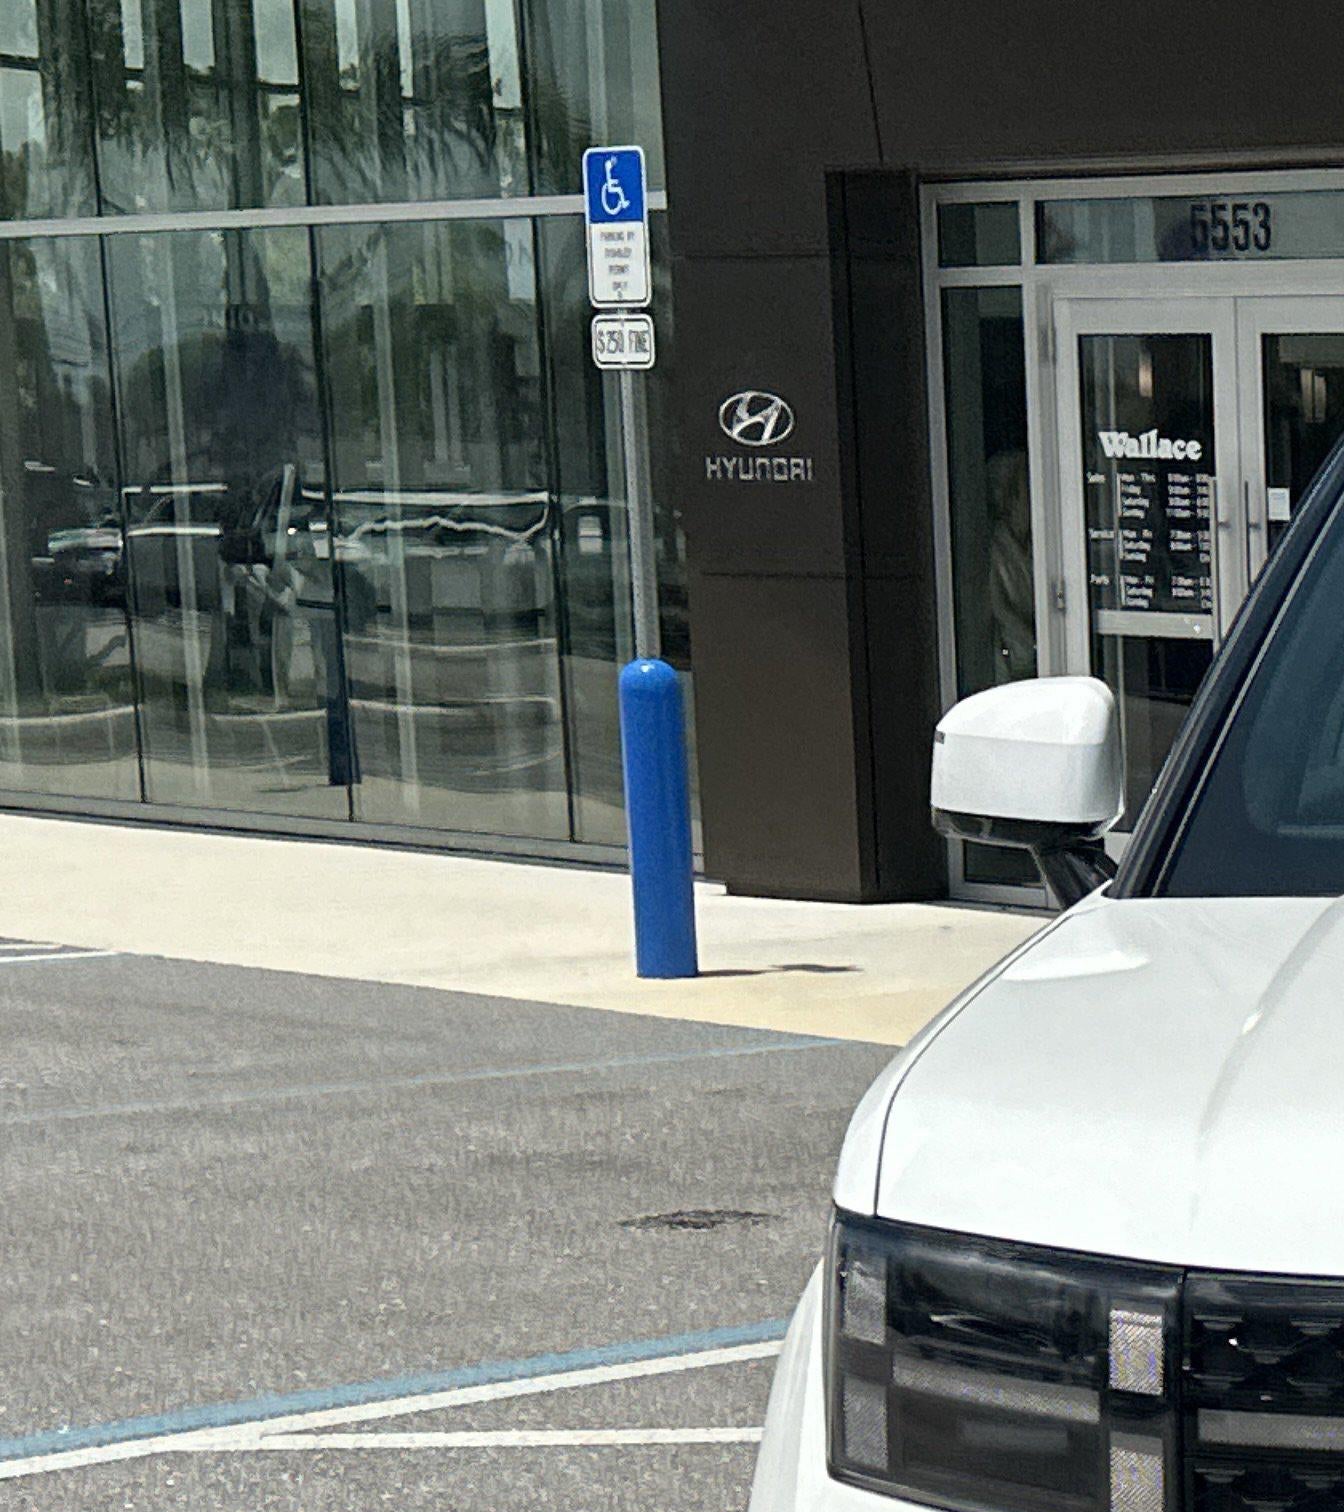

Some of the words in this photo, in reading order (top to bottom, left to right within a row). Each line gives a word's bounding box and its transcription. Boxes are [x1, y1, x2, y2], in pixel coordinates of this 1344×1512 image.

[1190, 202, 1272, 252] 5553
[1098, 428, 1202, 461] Wallace
[705, 457, 814, 481] HYUNDAI
